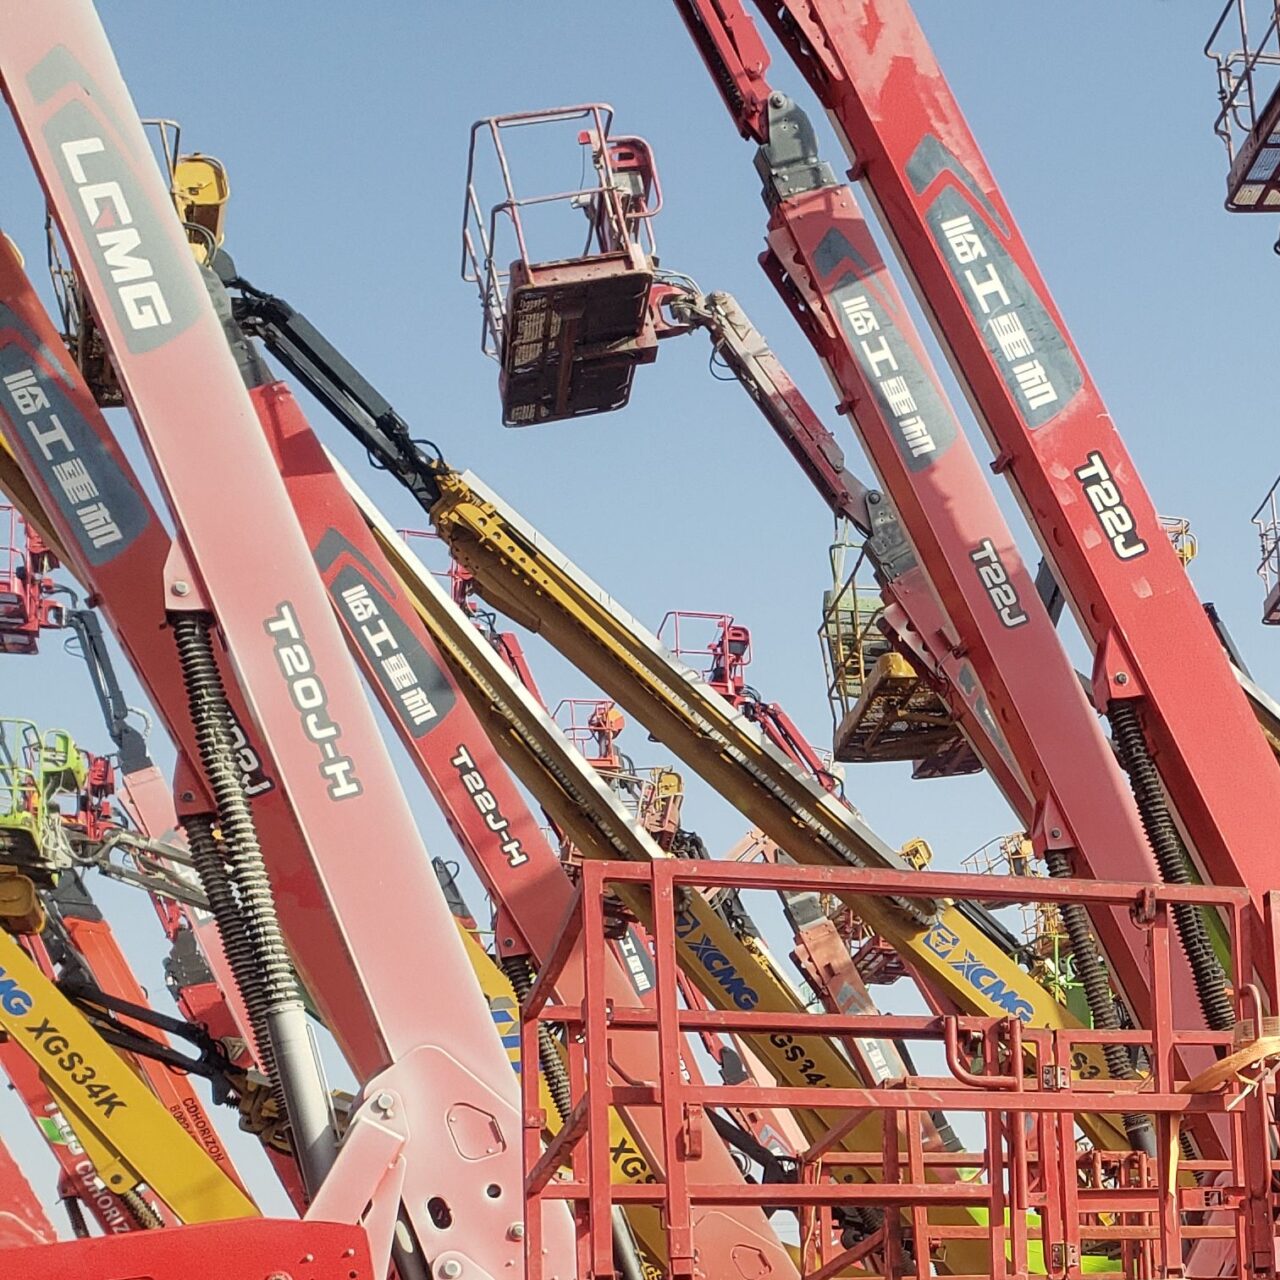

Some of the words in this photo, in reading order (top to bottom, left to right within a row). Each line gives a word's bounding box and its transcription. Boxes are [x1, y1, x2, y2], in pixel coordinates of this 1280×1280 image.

[1077, 454, 1143, 556] T22J
[970, 541, 1027, 628] T22J
[265, 606, 363, 798] T20J-H
[688, 933, 758, 1010] XCMG
[949, 948, 1034, 1023] XCMG
[25, 1017, 127, 1119] XGS34K
[182, 1097, 225, 1163] CDHORIZON
